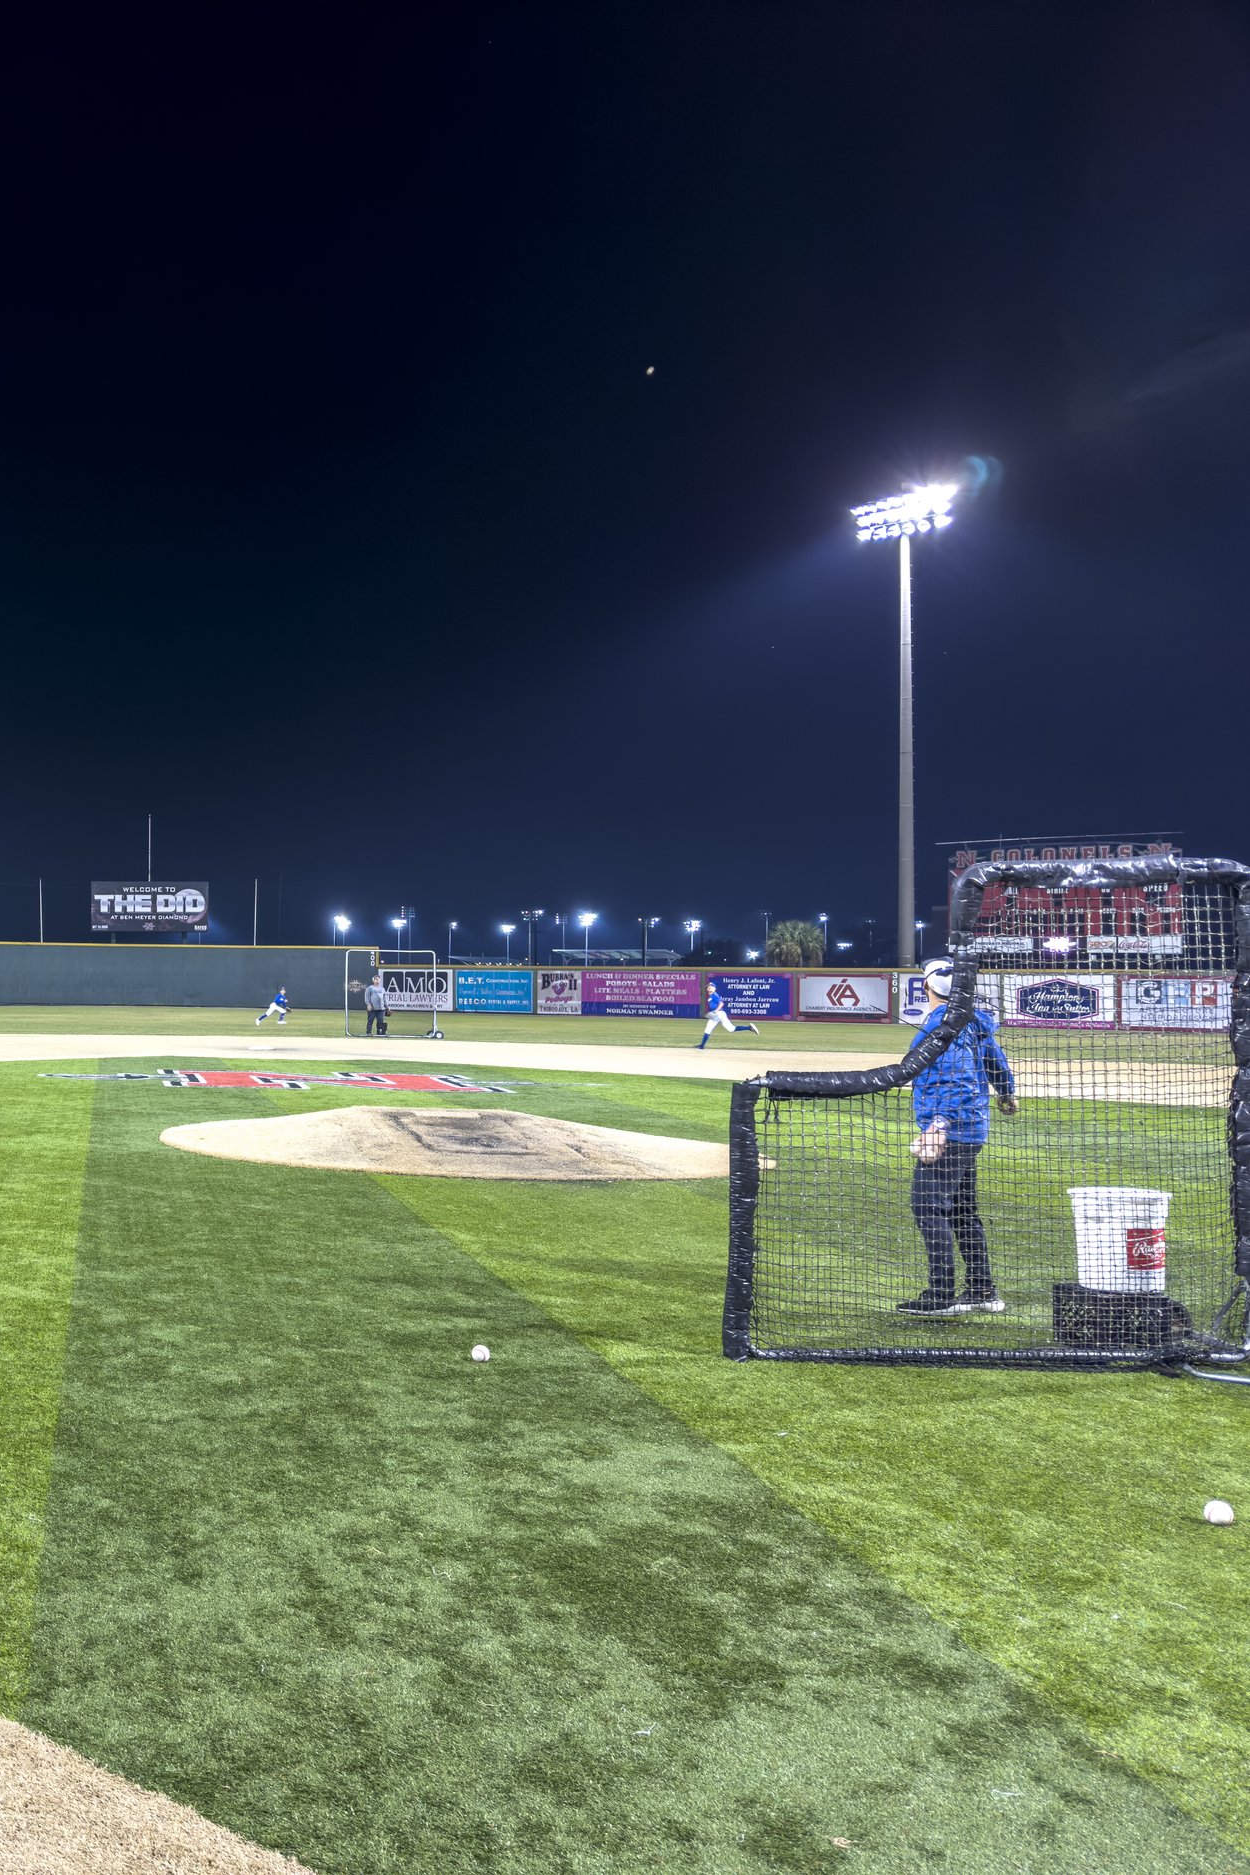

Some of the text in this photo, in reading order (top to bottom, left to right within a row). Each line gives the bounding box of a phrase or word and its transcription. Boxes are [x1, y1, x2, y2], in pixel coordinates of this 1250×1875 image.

[94, 894, 206, 913] THE DID
[387, 977, 447, 993] AMO
[458, 977, 485, 985] B.E.T.
[541, 973, 575, 990] BUBBA'S
